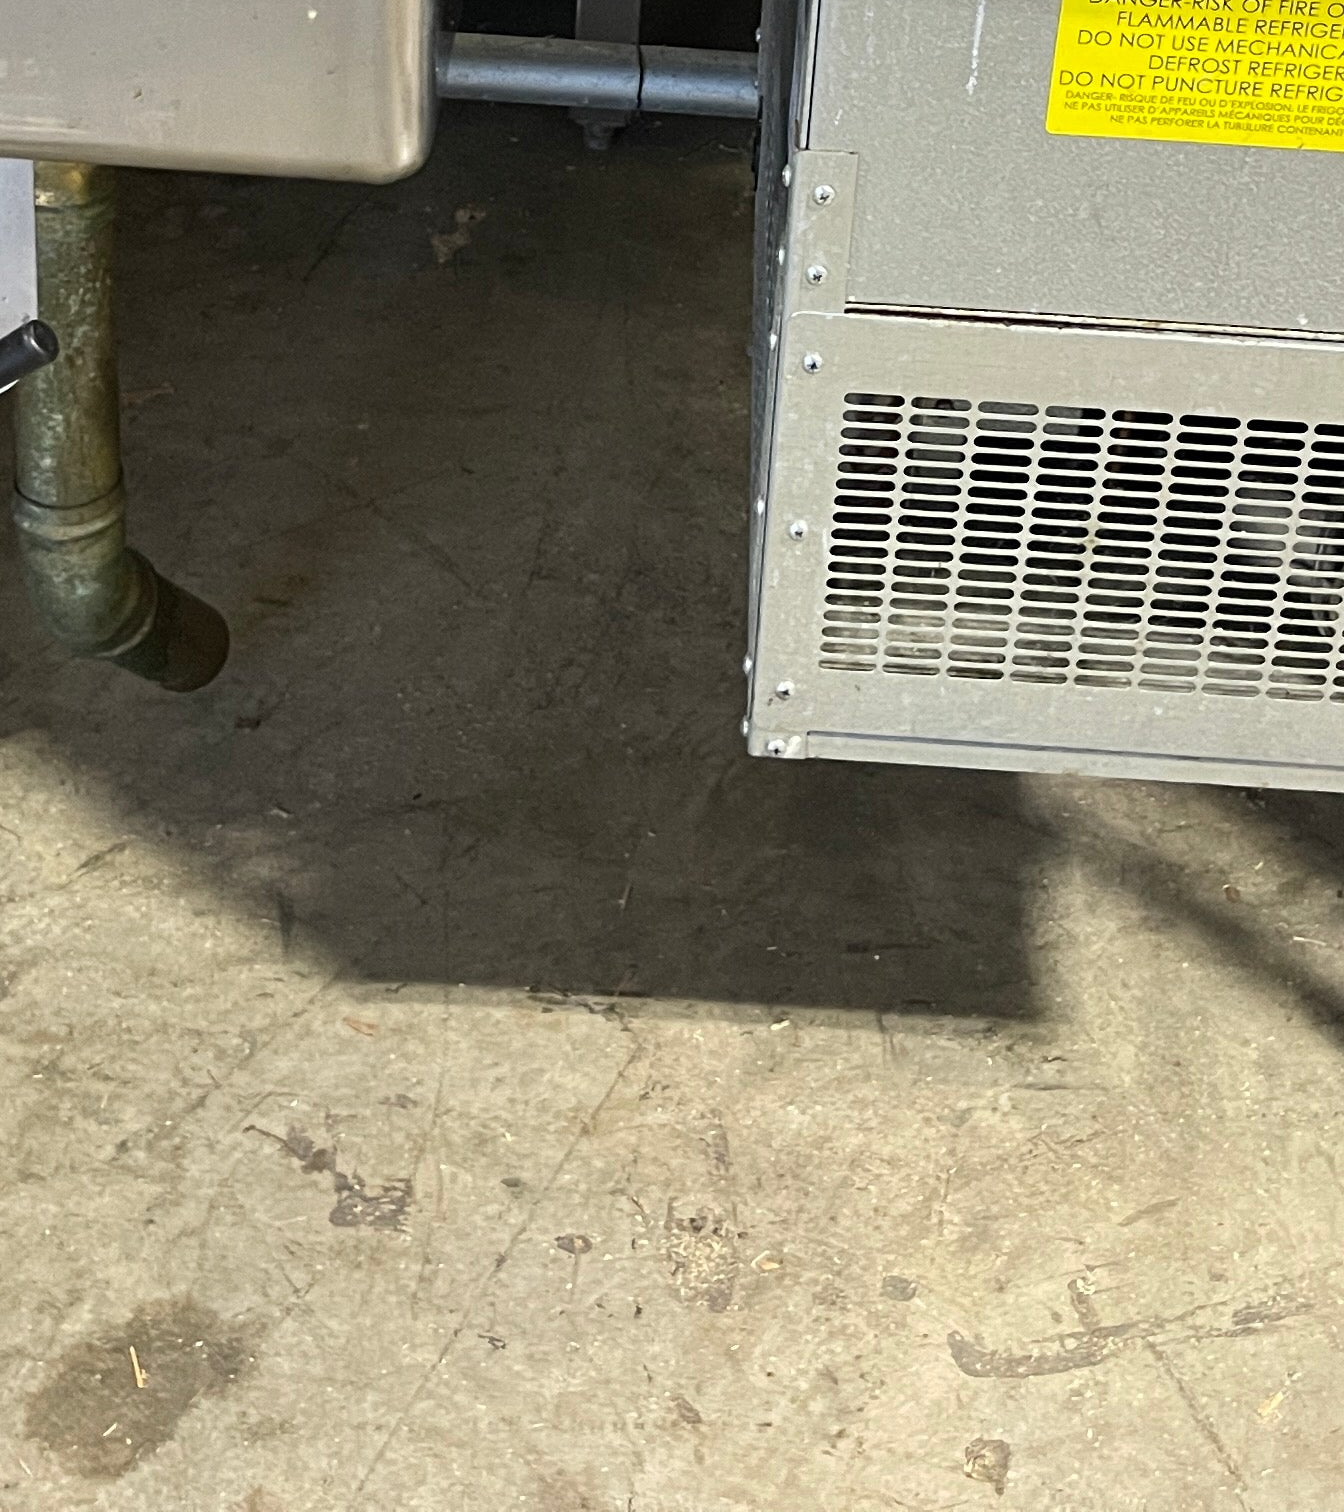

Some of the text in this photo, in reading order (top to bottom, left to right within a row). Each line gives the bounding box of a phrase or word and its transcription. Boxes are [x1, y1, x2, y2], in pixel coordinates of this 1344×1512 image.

[1279, 0, 1321, 17] FIRE
[1117, 10, 1248, 34] FLAMMABLE
[1077, 29, 1112, 46] DO
[1119, 32, 1165, 50] NOT
[1171, 35, 1209, 52] USE
[1148, 54, 1242, 75] DEFROST
[1059, 70, 1094, 87] DO
[1100, 72, 1146, 89] NOT
[1152, 75, 1264, 98] PUNCTURE
[1064, 101, 1079, 110] NE
[1081, 102, 1102, 112] PAS
[1105, 103, 1145, 114] UTILISER
[1294, 114, 1323, 125] POUR
[1119, 92, 1158, 105] RISQUE
[1160, 95, 1175, 106] DE
[1177, 96, 1197, 106] FEU
[1199, 98, 1216, 108] OU
[1297, 104, 1309, 114] LE
[1110, 114, 1124, 124] NE
[1127, 116, 1148, 125] PAS
[1150, 117, 1205, 129] PERFORER
[1207, 120, 1220, 129] LA
[1277, 125, 1344, 138] CONTENANT
